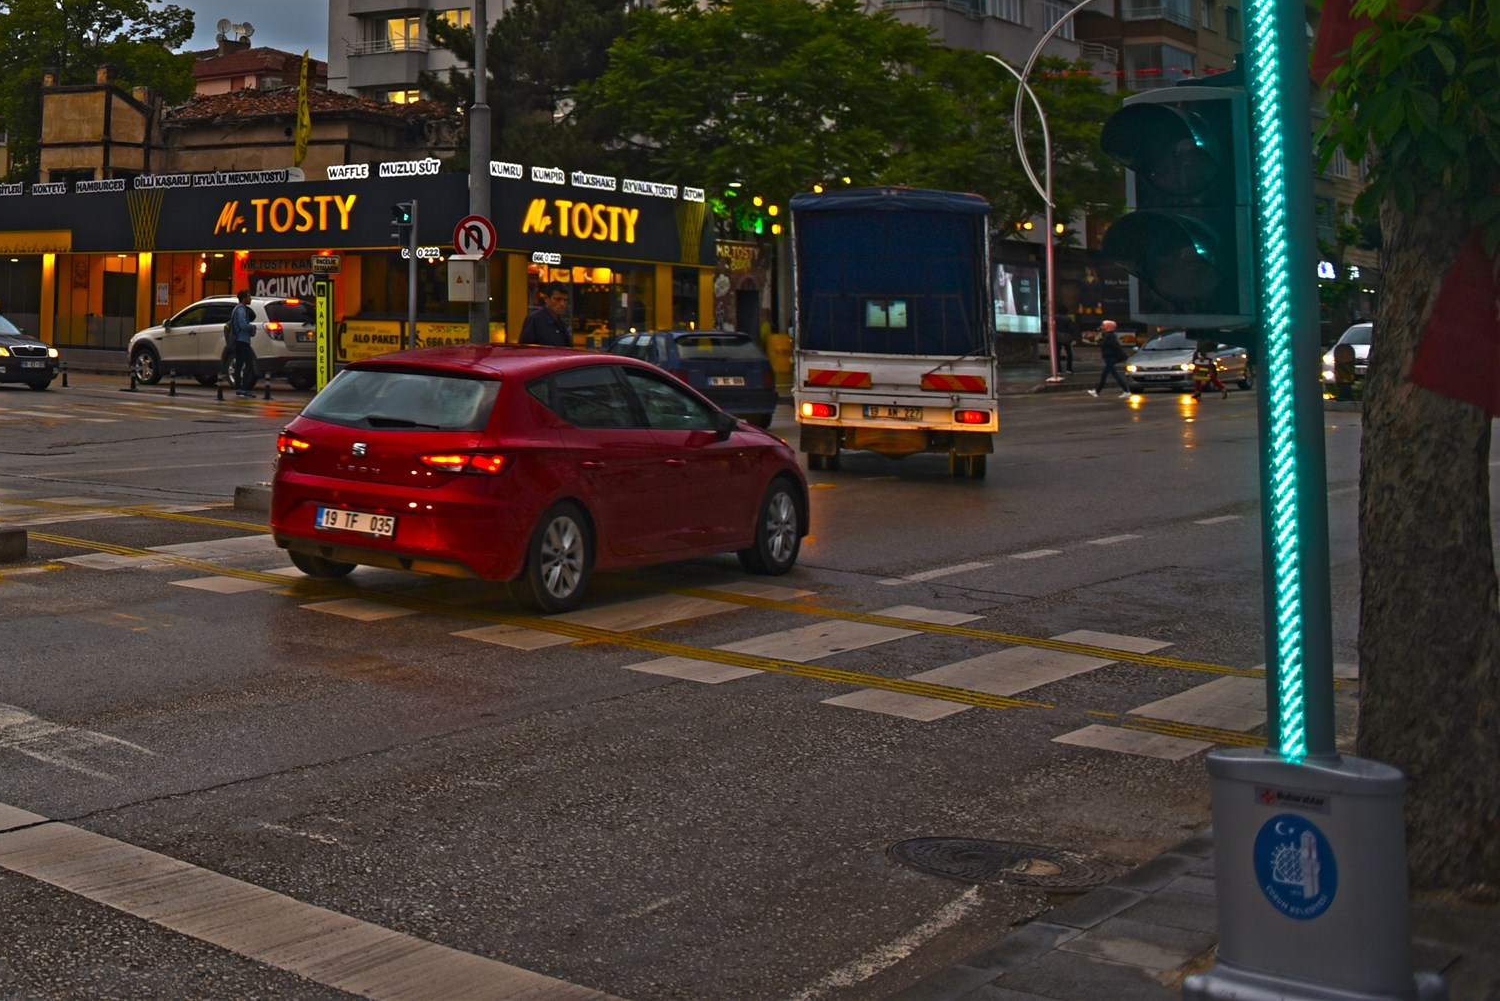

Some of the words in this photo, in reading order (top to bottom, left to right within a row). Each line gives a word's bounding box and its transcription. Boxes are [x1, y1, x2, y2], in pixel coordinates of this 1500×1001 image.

[329, 166, 368, 178] WAFFLE
[380, 162, 417, 175] MUZLU
[418, 159, 439, 173] SÜT
[32, 183, 66, 195] KOKTEYL
[76, 180, 124, 193] HAMBURGER
[193, 174, 215, 186] LEYLA
[228, 172, 260, 184] MECNUN
[261, 170, 286, 182] TOSTU
[491, 163, 522, 177] KUMRU
[533, 168, 564, 183] KUMPİR
[573, 172, 616, 188] MİLKSHAKE
[623, 181, 653, 194] AYVALIK
[654, 185, 678, 197] TOSTU
[684, 188, 703, 199] ATOM
[214, 201, 248, 235] Mr.
[251, 195, 357, 233] TOSTY
[555, 199, 639, 244] TOSTY
[425, 248, 439, 257] 222
[353, 334, 369, 343] ALO
[372, 334, 399, 344] PAKET
[870, 408, 879, 417] 19
[887, 408, 899, 417] AN
[904, 408, 921, 418] 227
[337, 464, 380, 472] LEON
[325, 510, 338, 526] 19
[345, 513, 359, 529] TF
[370, 516, 393, 533] 035
